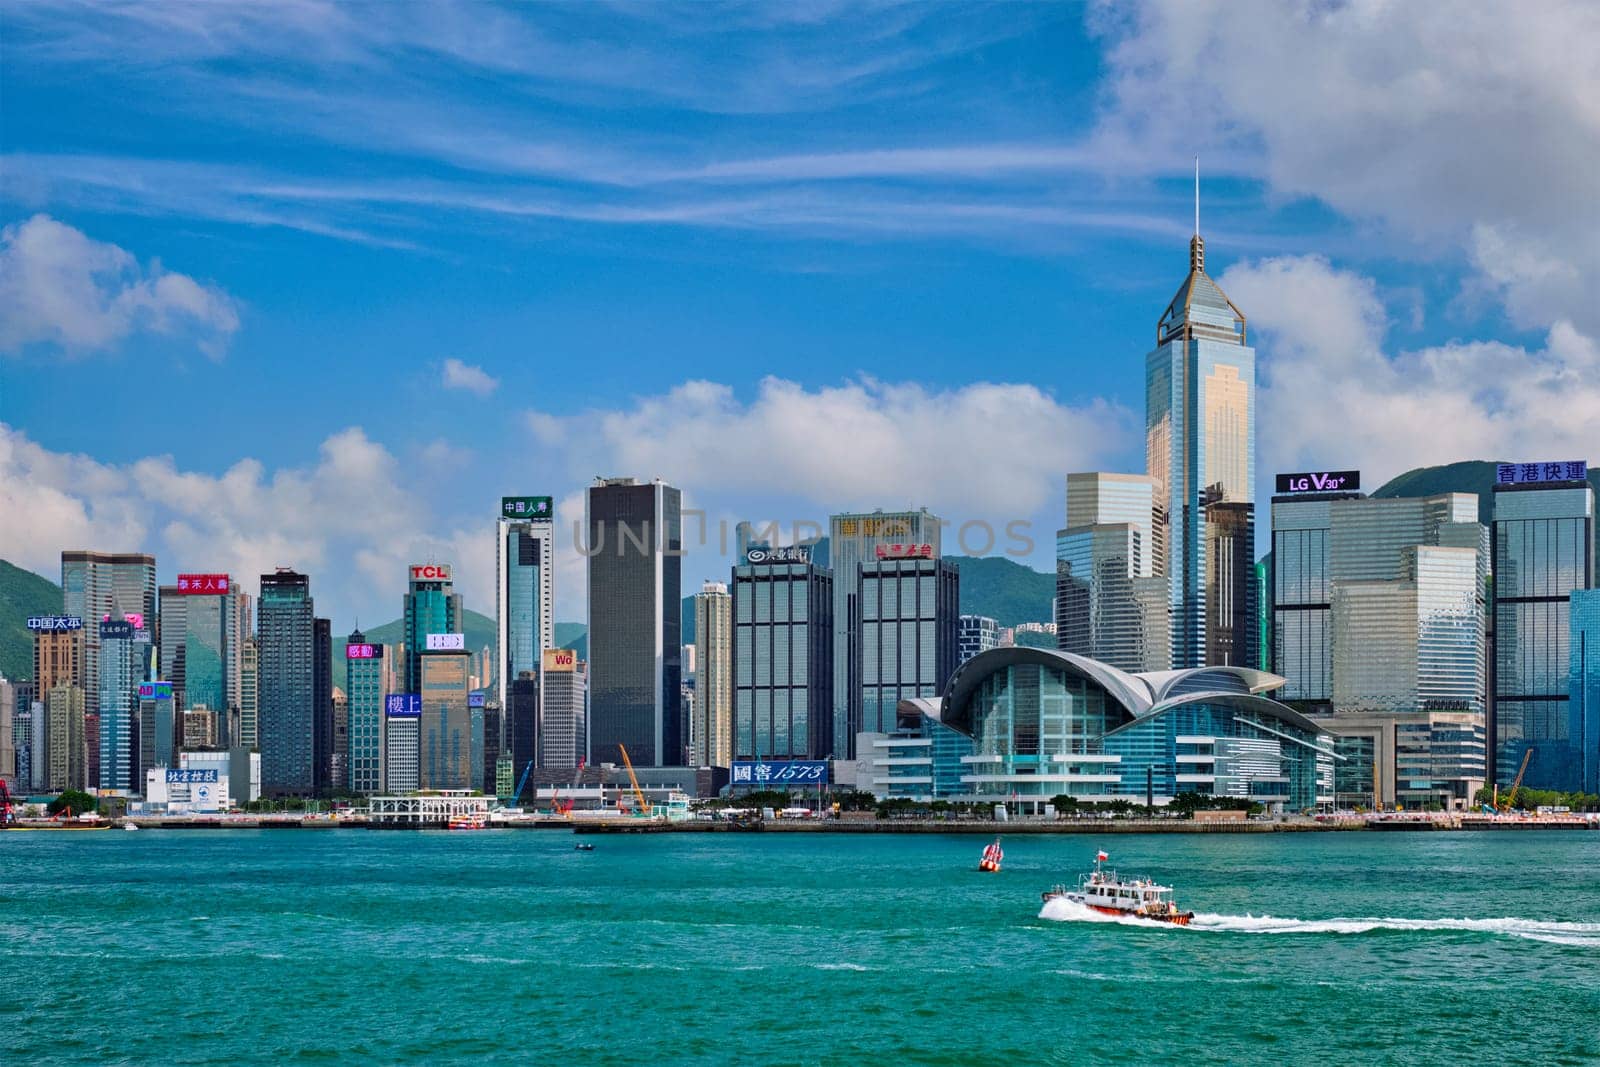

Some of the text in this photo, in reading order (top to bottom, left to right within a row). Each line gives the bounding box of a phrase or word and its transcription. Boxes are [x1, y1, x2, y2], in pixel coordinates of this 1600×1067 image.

[1499, 461, 1585, 482] 香港快運
[1290, 478, 1309, 491] LG
[411, 566, 448, 579] TCL
[28, 617, 81, 630] 中国太平
[555, 655, 573, 665] Wo
[388, 695, 421, 713] 樓上
